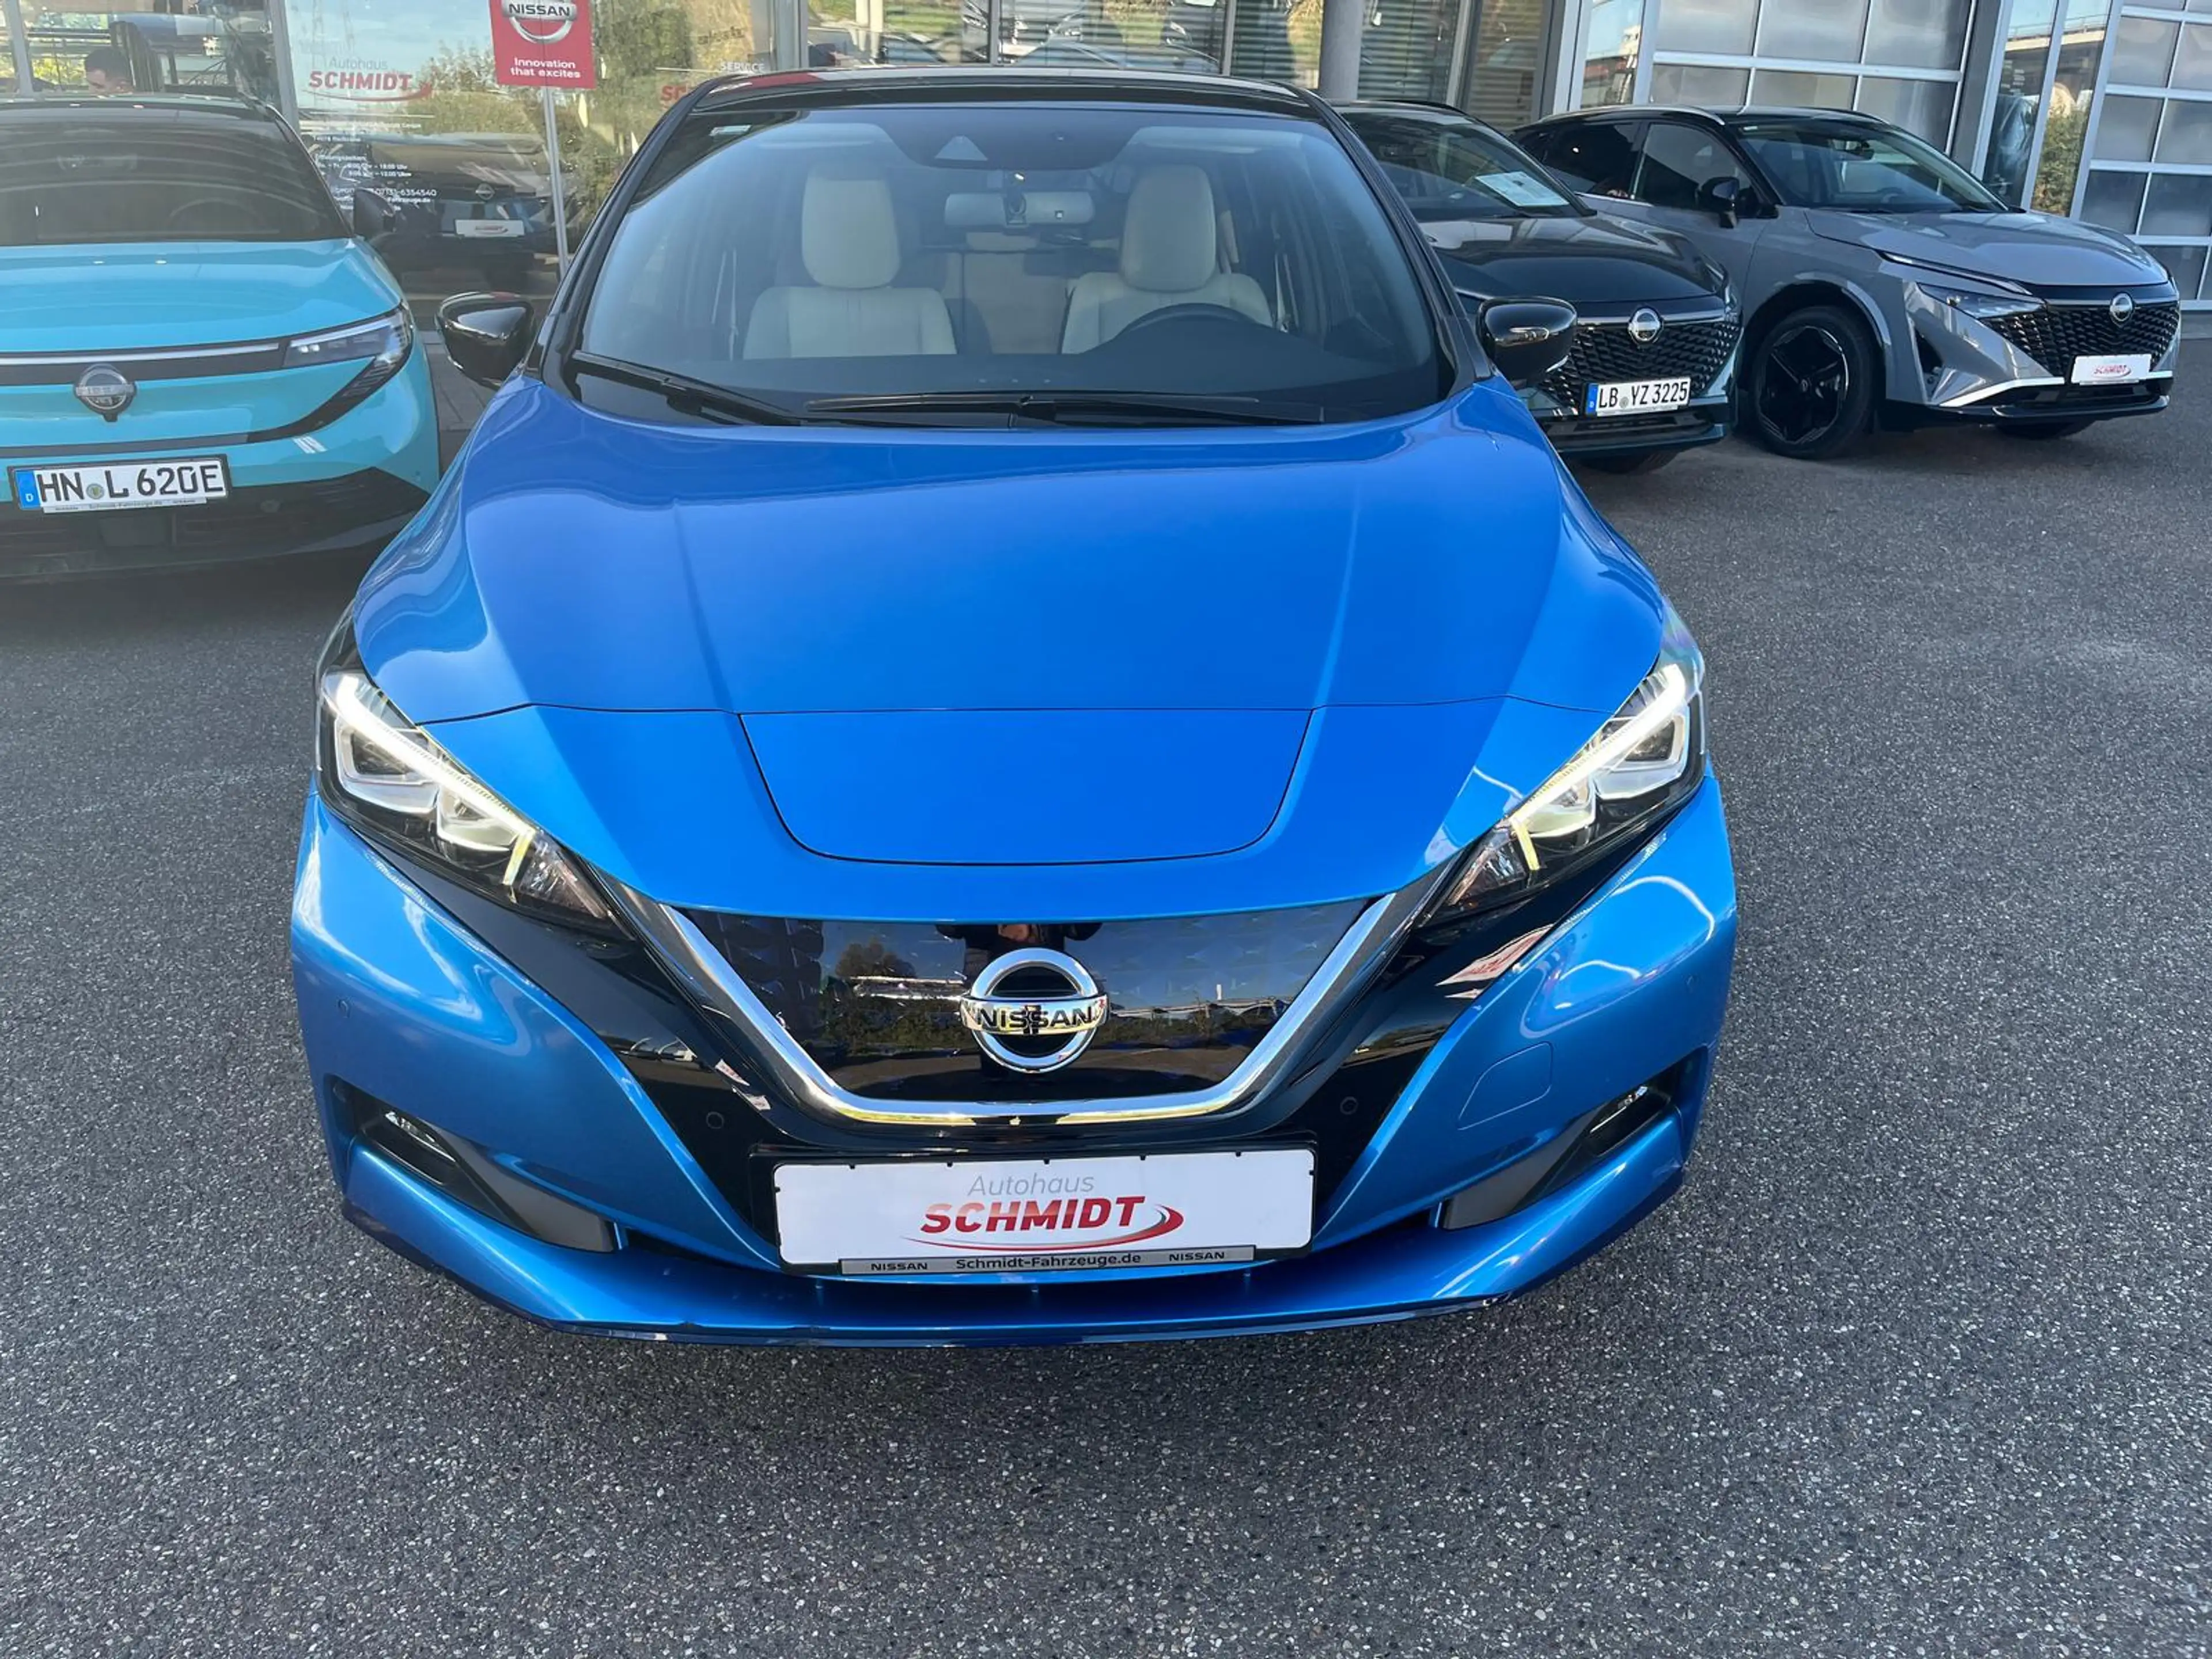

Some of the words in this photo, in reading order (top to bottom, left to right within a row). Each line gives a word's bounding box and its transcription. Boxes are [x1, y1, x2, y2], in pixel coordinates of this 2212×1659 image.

[509, 3, 570, 16] NISSAN
[329, 58, 388, 70] Autohaus
[511, 67, 535, 76] that
[539, 69, 581, 78] excites
[514, 57, 576, 69] Innovation
[720, 62, 765, 72] SERVICE
[309, 70, 413, 90] SCHMIDT
[1599, 387, 1618, 408] LB
[1631, 385, 1647, 406] YZ
[1652, 381, 1688, 403] 3225
[37, 472, 84, 502] HN
[105, 470, 129, 498] L
[137, 464, 224, 496] 620E
[26, 493, 33, 502] D
[977, 1006, 1092, 1028] NISSAN
[968, 1173, 1094, 1196] Autohaus
[920, 1196, 1146, 1234] SCHMIDT
[871, 1262, 927, 1271] NISSAN
[956, 1253, 1141, 1270] Schmidt-Fahrzeuge.de
[1169, 1252, 1225, 1262] NISSAN
